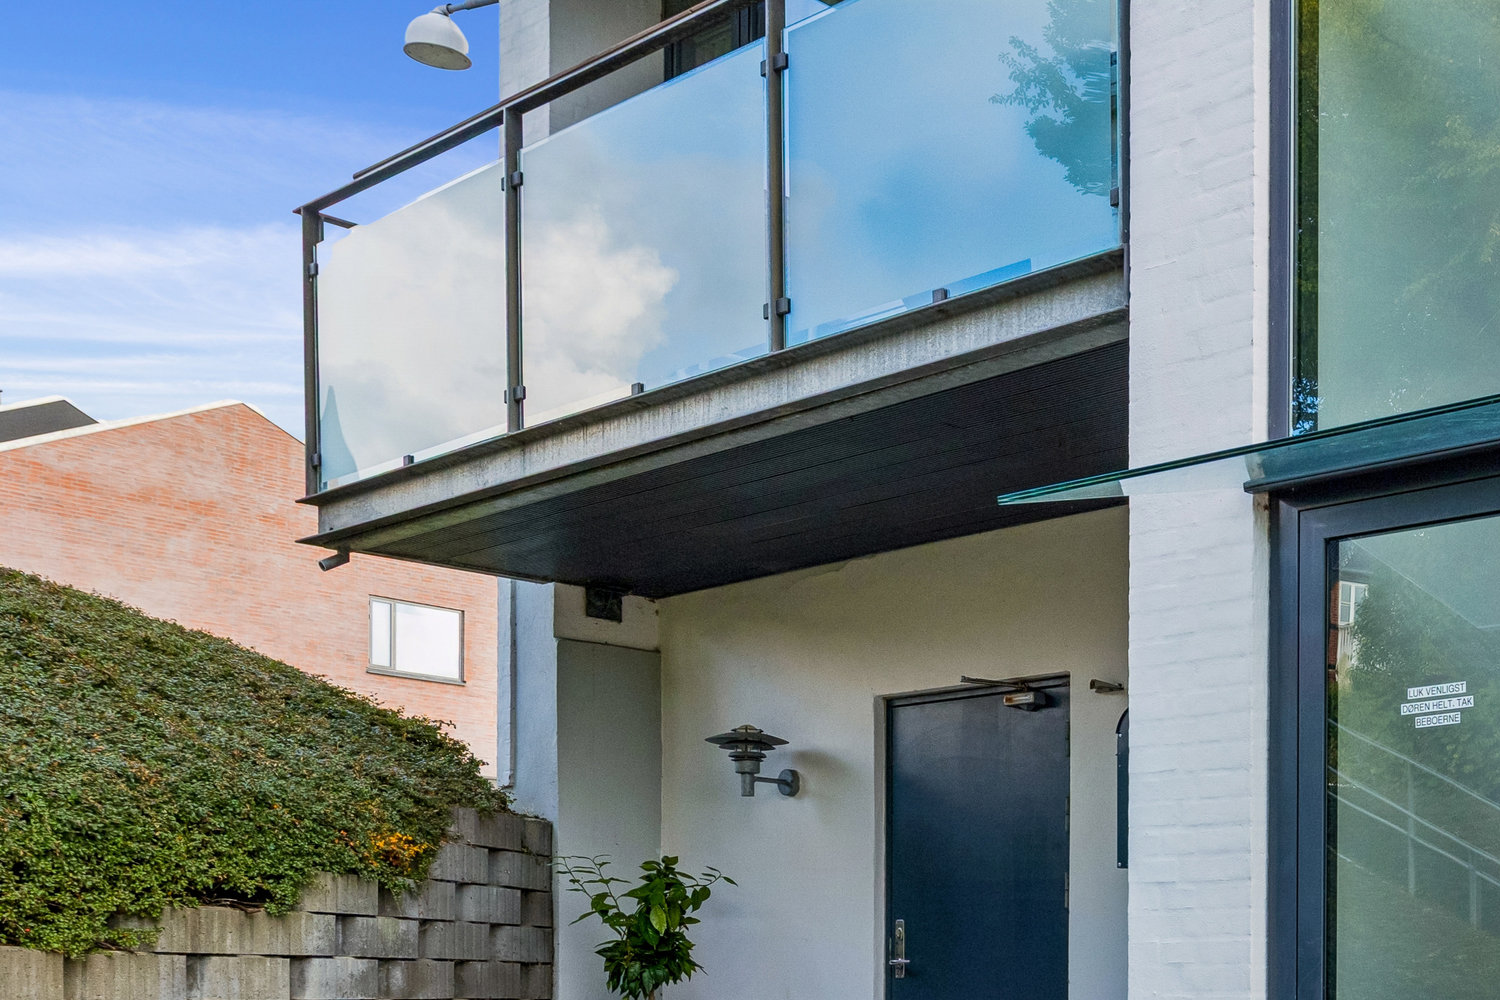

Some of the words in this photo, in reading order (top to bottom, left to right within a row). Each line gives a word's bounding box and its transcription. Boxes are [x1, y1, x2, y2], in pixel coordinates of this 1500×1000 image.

[1408, 688, 1424, 698] LUK
[1425, 683, 1465, 695] VENLIGST
[1402, 702, 1430, 714] DØREN
[1457, 697, 1473, 707] TAK
[1416, 713, 1460, 727] BEBOERNE
